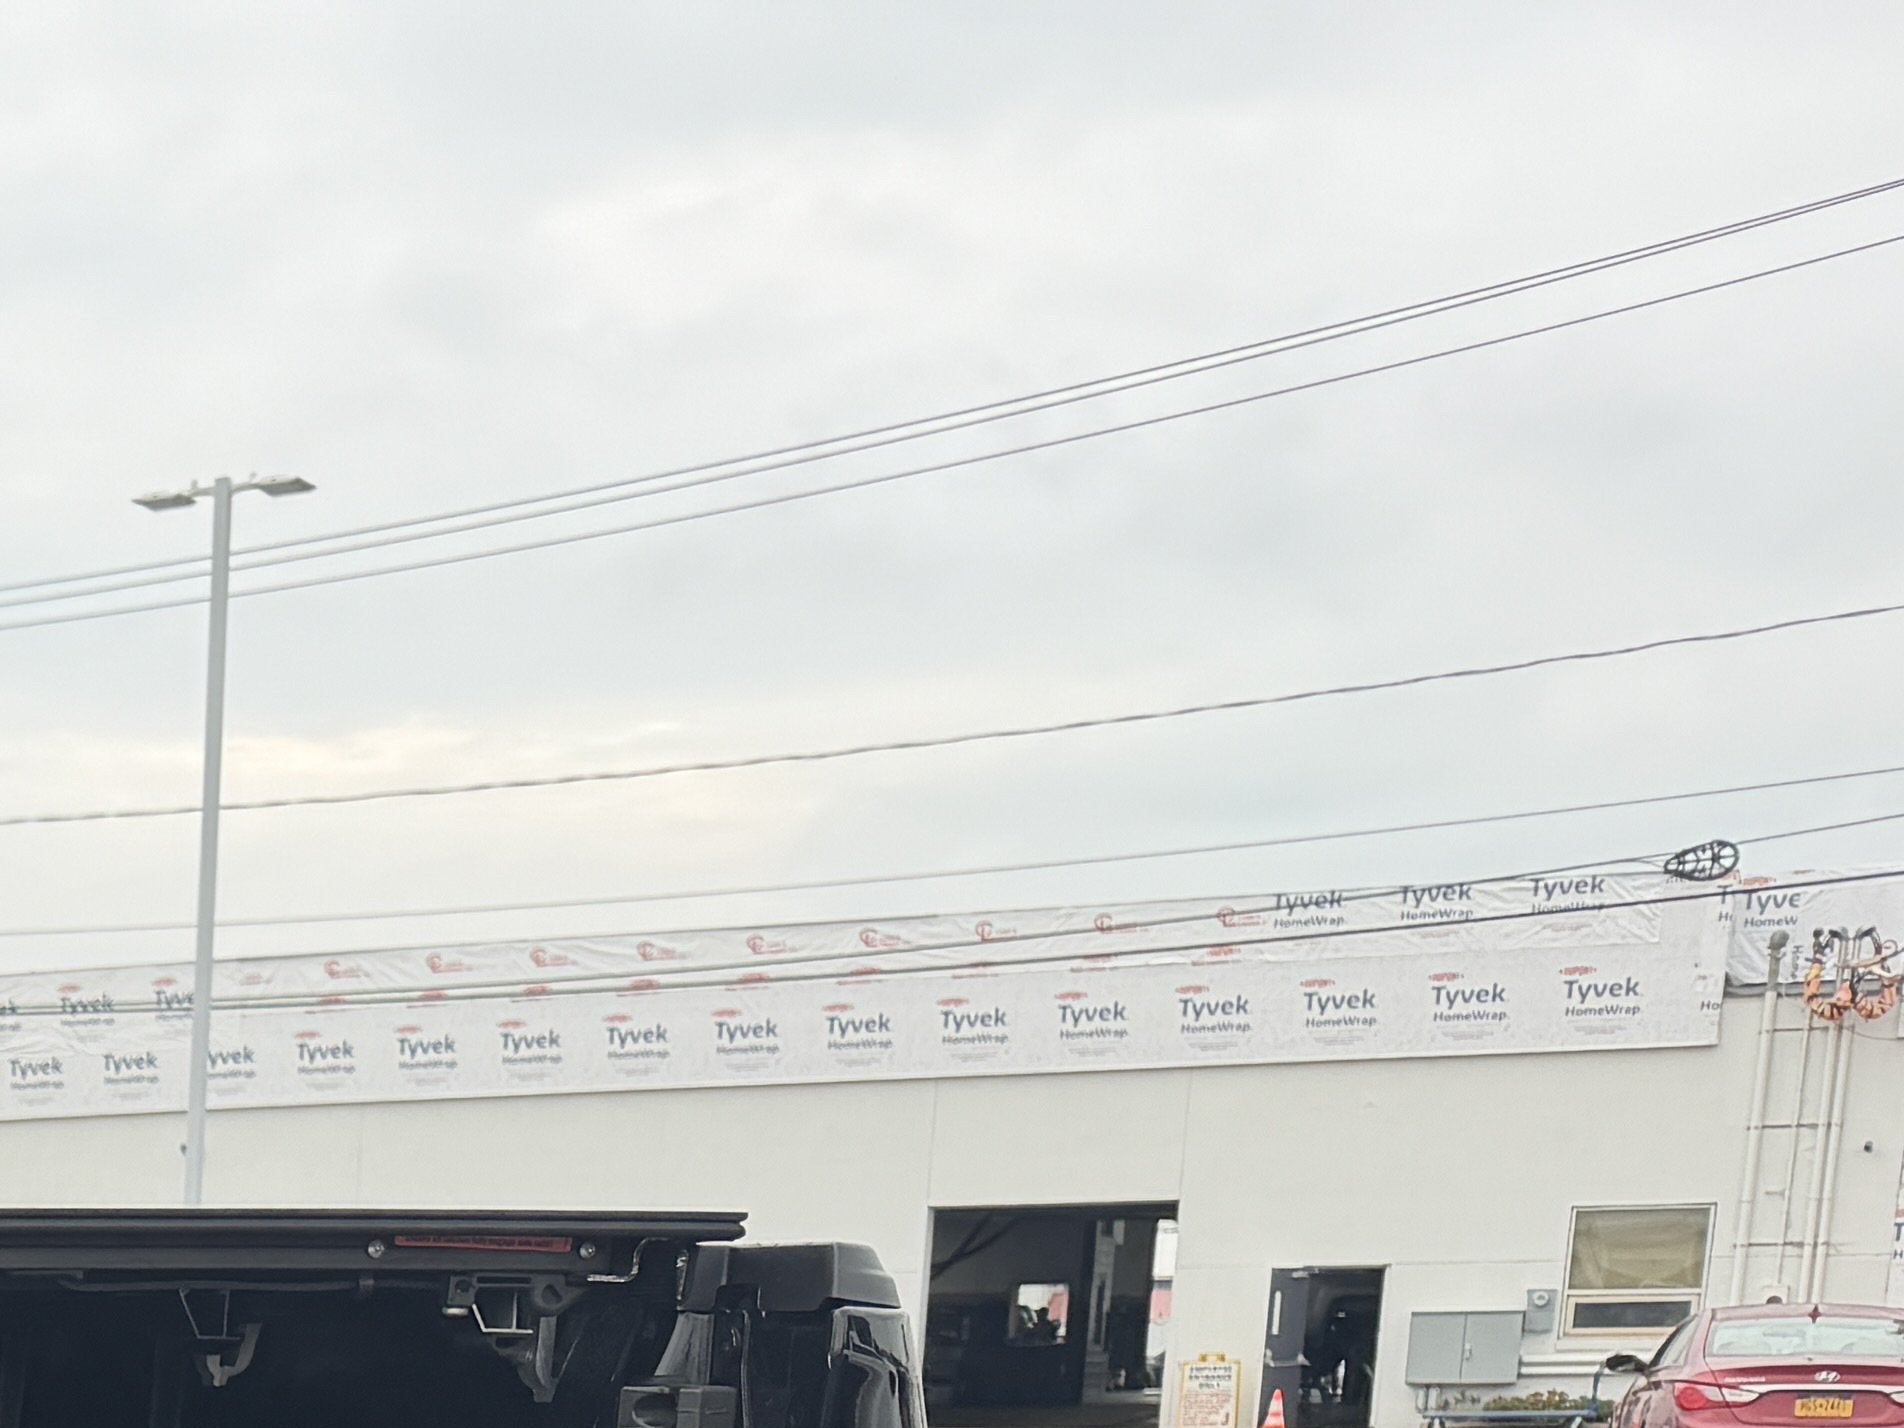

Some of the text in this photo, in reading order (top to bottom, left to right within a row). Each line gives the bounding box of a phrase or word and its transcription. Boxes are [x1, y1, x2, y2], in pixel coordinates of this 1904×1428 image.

[1401, 884, 1472, 908] Tyvek
[1530, 875, 1605, 901] Tyvek
[1274, 890, 1343, 916] Tyvek
[1401, 908, 1473, 921] HomeWrap
[1743, 891, 1801, 915] Tyve
[1274, 916, 1344, 928] HomeWrap
[1744, 916, 1797, 928] HomeW
[1304, 989, 1375, 1015] Tyvek
[1432, 983, 1505, 1010] Tyvek
[1564, 977, 1639, 1004] Tyvek
[941, 1008, 1006, 1033] Tyvek
[1058, 1001, 1126, 1028] Tyvek
[1179, 995, 1248, 1022] Tyvek
[1433, 1010, 1507, 1022] HomeWrap
[1565, 1004, 1640, 1016] HomeWrap
[715, 1018, 777, 1044] Tyvek
[826, 1013, 890, 1038] Tyvek
[1060, 1028, 1128, 1040] HomeWrap
[1181, 1022, 1251, 1033] HomeWrap
[1306, 1016, 1377, 1028] HomeWrap
[398, 1035, 455, 1059] Tyvek
[501, 1030, 560, 1052] Tyvek
[607, 1024, 667, 1049] Tyvek
[103, 1052, 157, 1074] Tyvek
[208, 1046, 254, 1067] yvek
[298, 1040, 354, 1064] Tyvek
[10, 1057, 62, 1080] Tyvek
